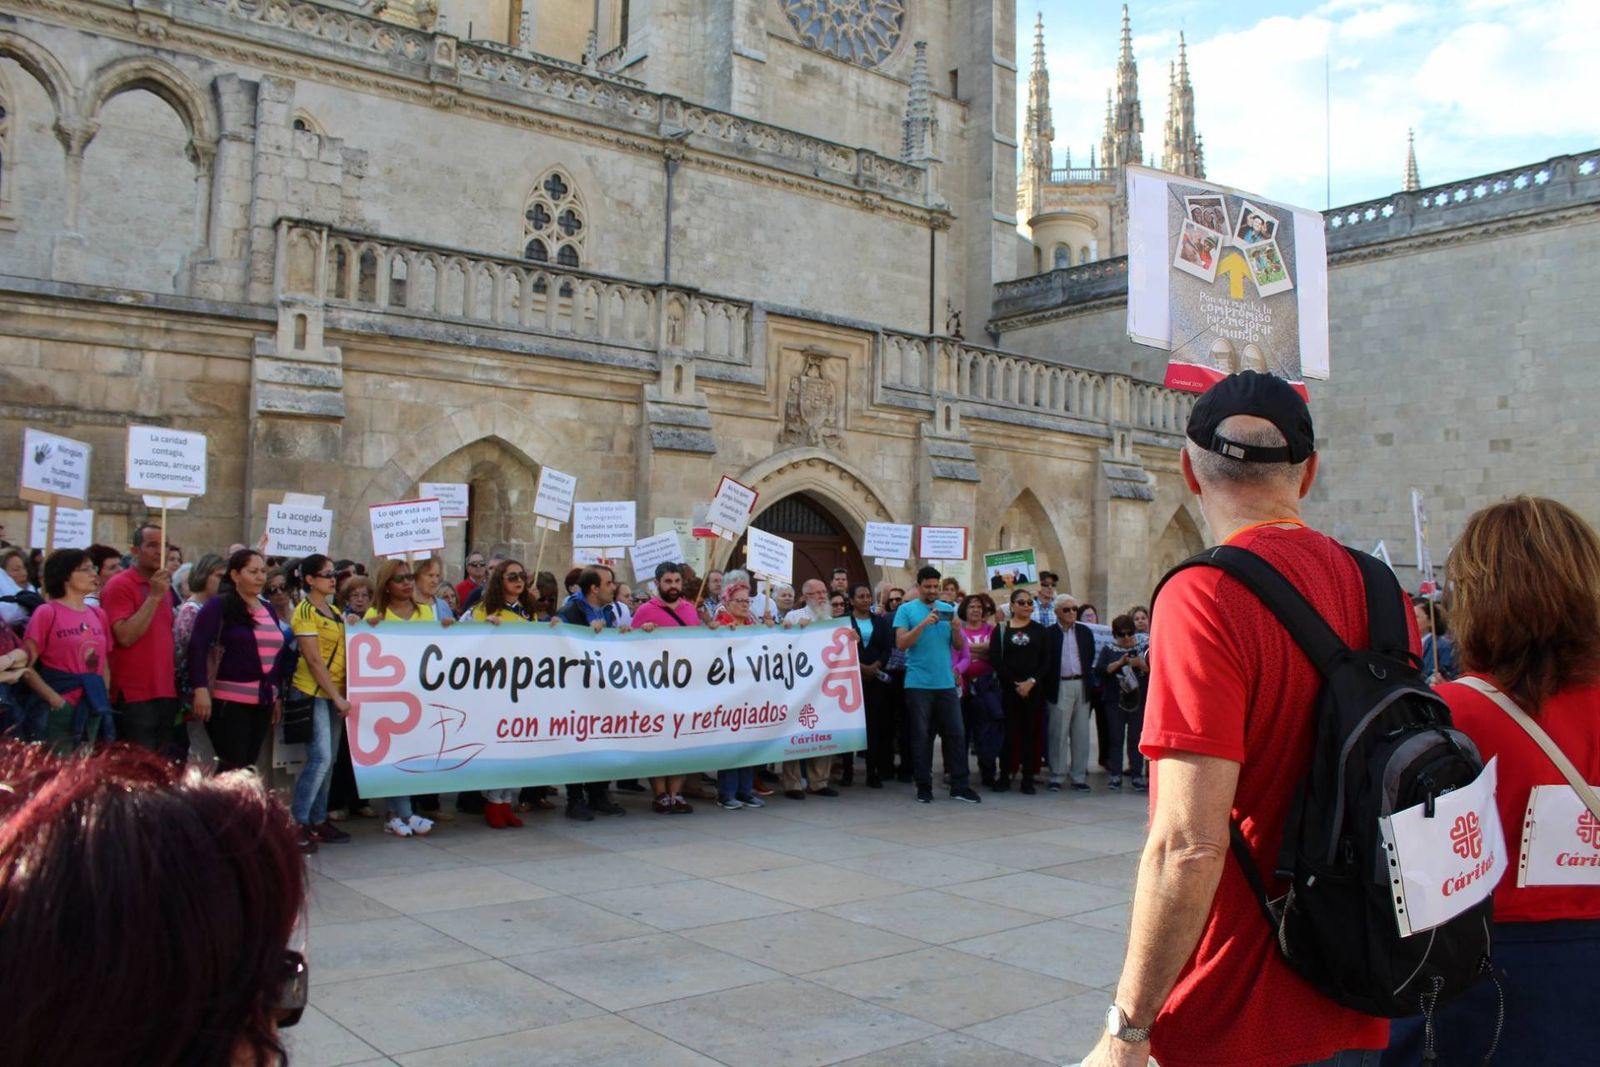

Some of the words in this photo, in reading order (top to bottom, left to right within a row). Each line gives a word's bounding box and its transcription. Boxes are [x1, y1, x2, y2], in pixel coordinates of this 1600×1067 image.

[1200, 291, 1216, 304] Pon
[1231, 298, 1261, 312] marcha
[1200, 303, 1271, 323] compromiso
[1207, 313, 1226, 325] para
[1228, 316, 1273, 335] mejorar
[1210, 323, 1219, 334] el
[1220, 327, 1259, 342] mundo
[160, 436, 188, 446] caridad
[152, 448, 184, 458] contagia,
[134, 458, 171, 468] apasiona,
[172, 462, 200, 472] arriesga
[277, 510, 286, 520] La
[289, 513, 322, 523] acogida
[268, 527, 286, 535] nos
[287, 526, 308, 536] hace
[310, 528, 328, 538] más
[374, 521, 394, 530] juego
[396, 530, 412, 538] cada
[277, 541, 317, 552] humanos
[419, 644, 692, 703] Compartiendo
[706, 646, 735, 686] el
[746, 644, 814, 690] viaje
[496, 712, 538, 738] con
[549, 710, 664, 742] migrantes
[673, 712, 685, 739] y
[691, 701, 788, 732] refugiados
[1442, 851, 1494, 896] Cáritas
